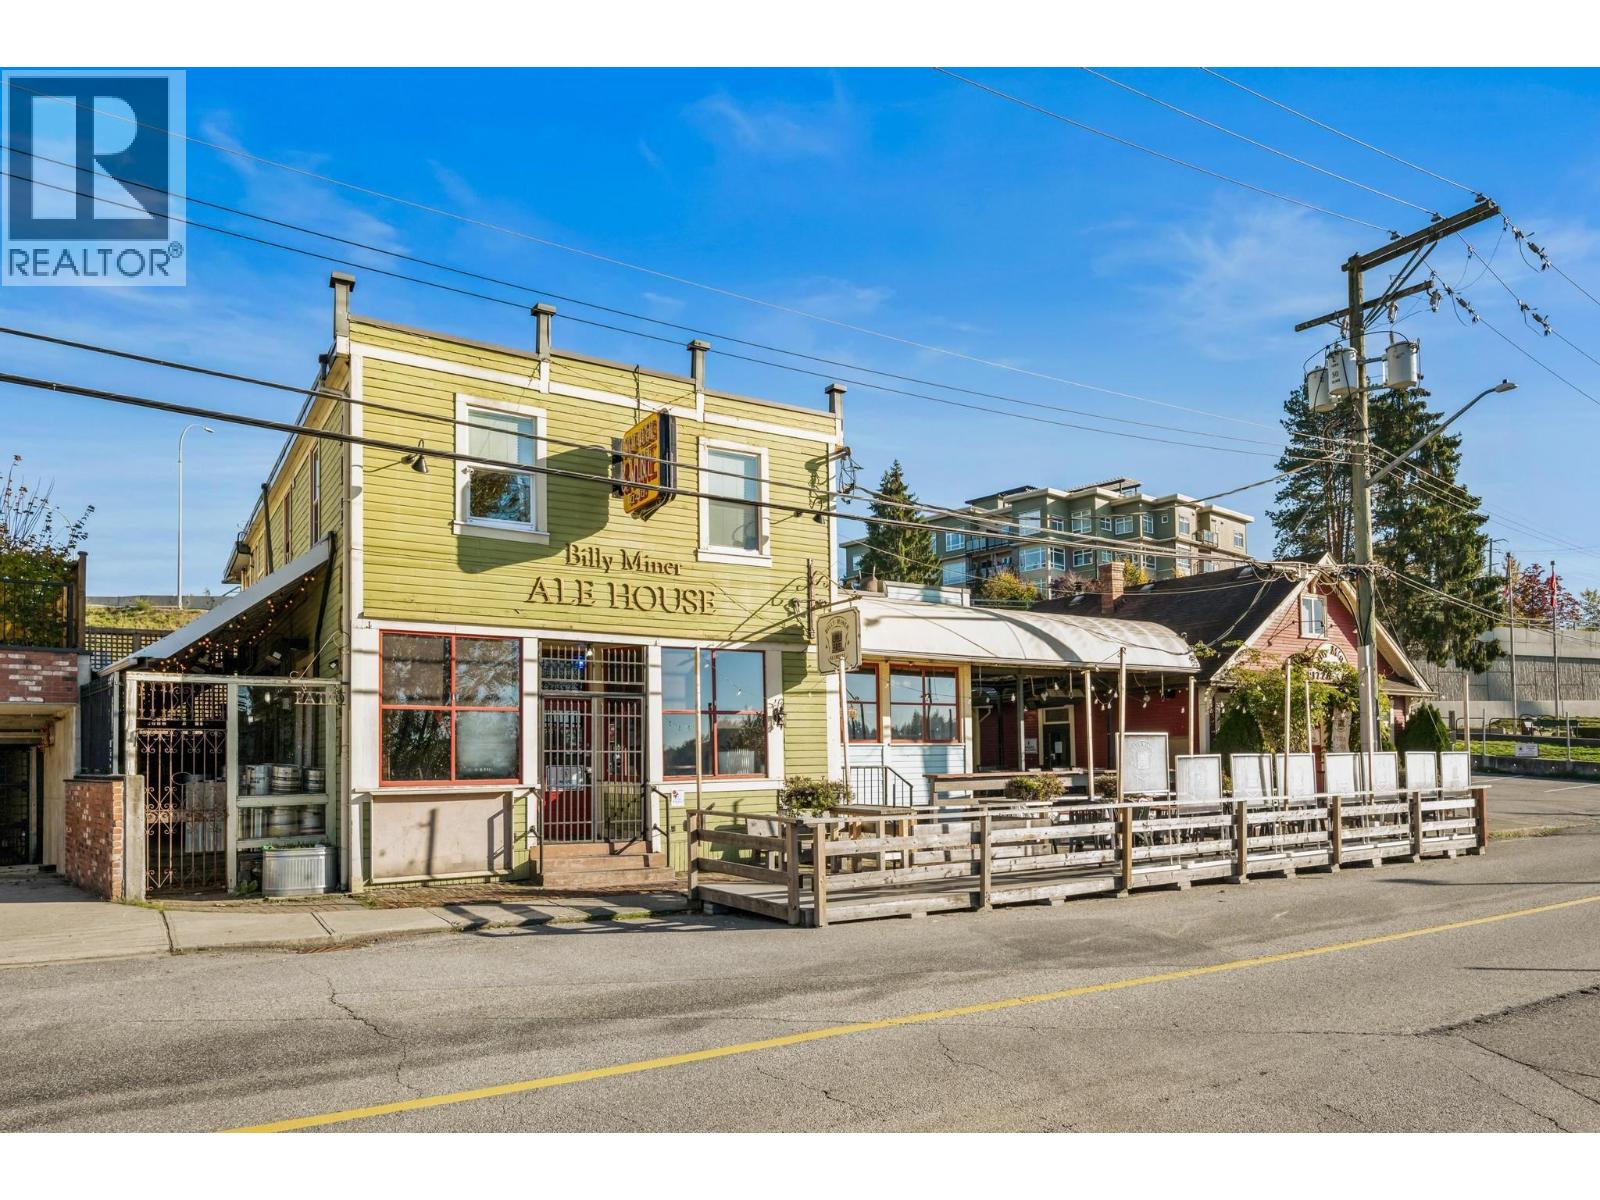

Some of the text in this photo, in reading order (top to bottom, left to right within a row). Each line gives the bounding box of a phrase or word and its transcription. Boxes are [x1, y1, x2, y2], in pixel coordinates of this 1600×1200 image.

[565, 542, 683, 576] Billy Miner
[524, 576, 717, 615] ALE HOUSE
[294, 691, 346, 706] PATIO
